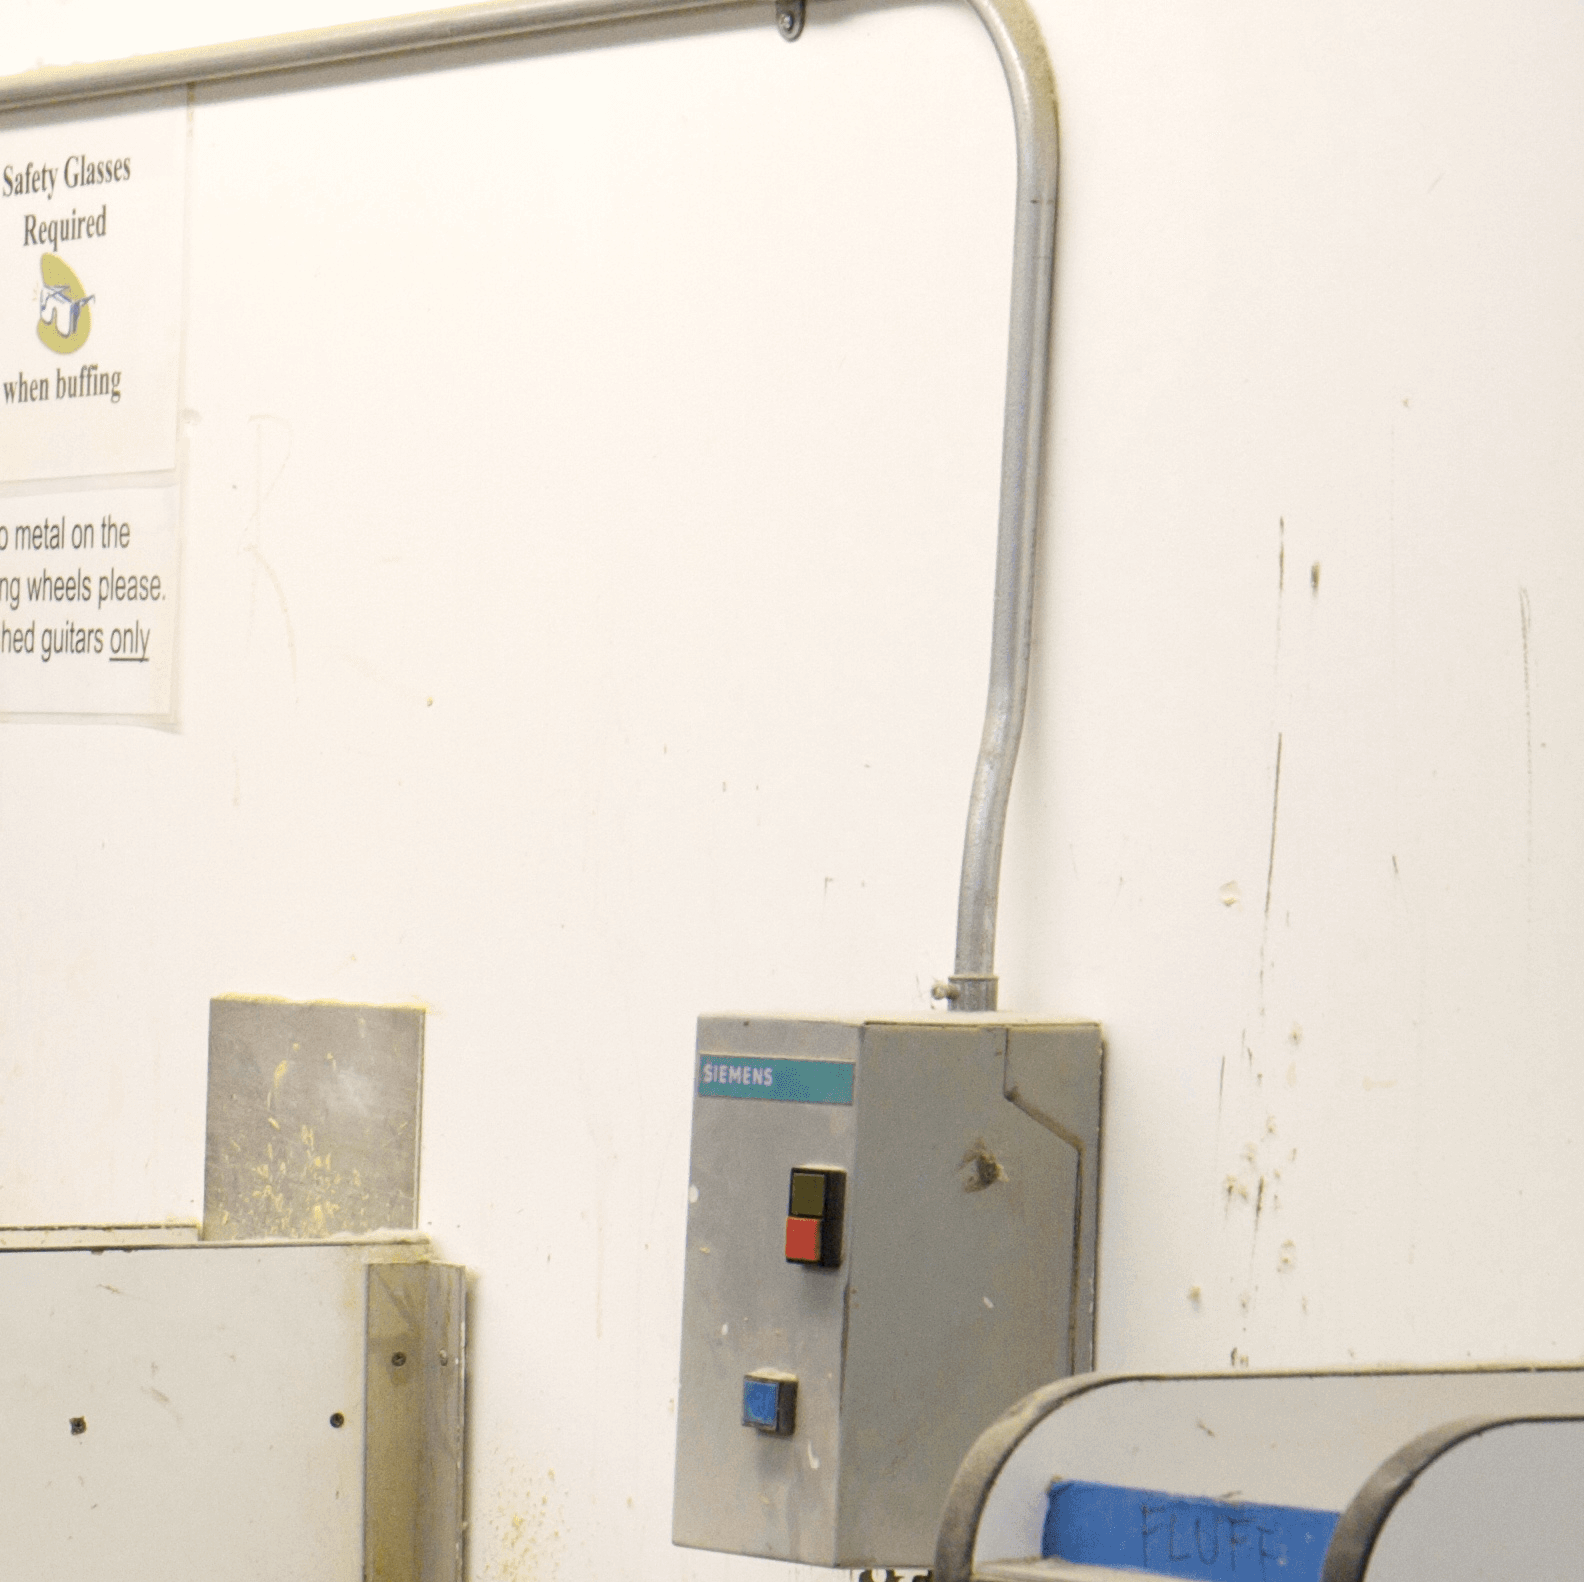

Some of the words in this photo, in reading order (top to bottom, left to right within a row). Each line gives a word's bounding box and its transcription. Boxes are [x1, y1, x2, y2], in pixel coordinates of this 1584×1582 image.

[2, 162, 58, 200] Safety
[64, 155, 131, 188] Glasses
[23, 204, 107, 252] Required
[3, 371, 49, 404] when
[56, 364, 122, 404] buffing
[14, 515, 65, 550] metal
[71, 523, 94, 550] on
[101, 514, 130, 549] the
[27, 567, 92, 602] wheels
[98, 567, 166, 610] please.
[41, 620, 104, 662] guitars
[109, 619, 150, 663] only
[702, 1062, 773, 1087] SIEMENS
